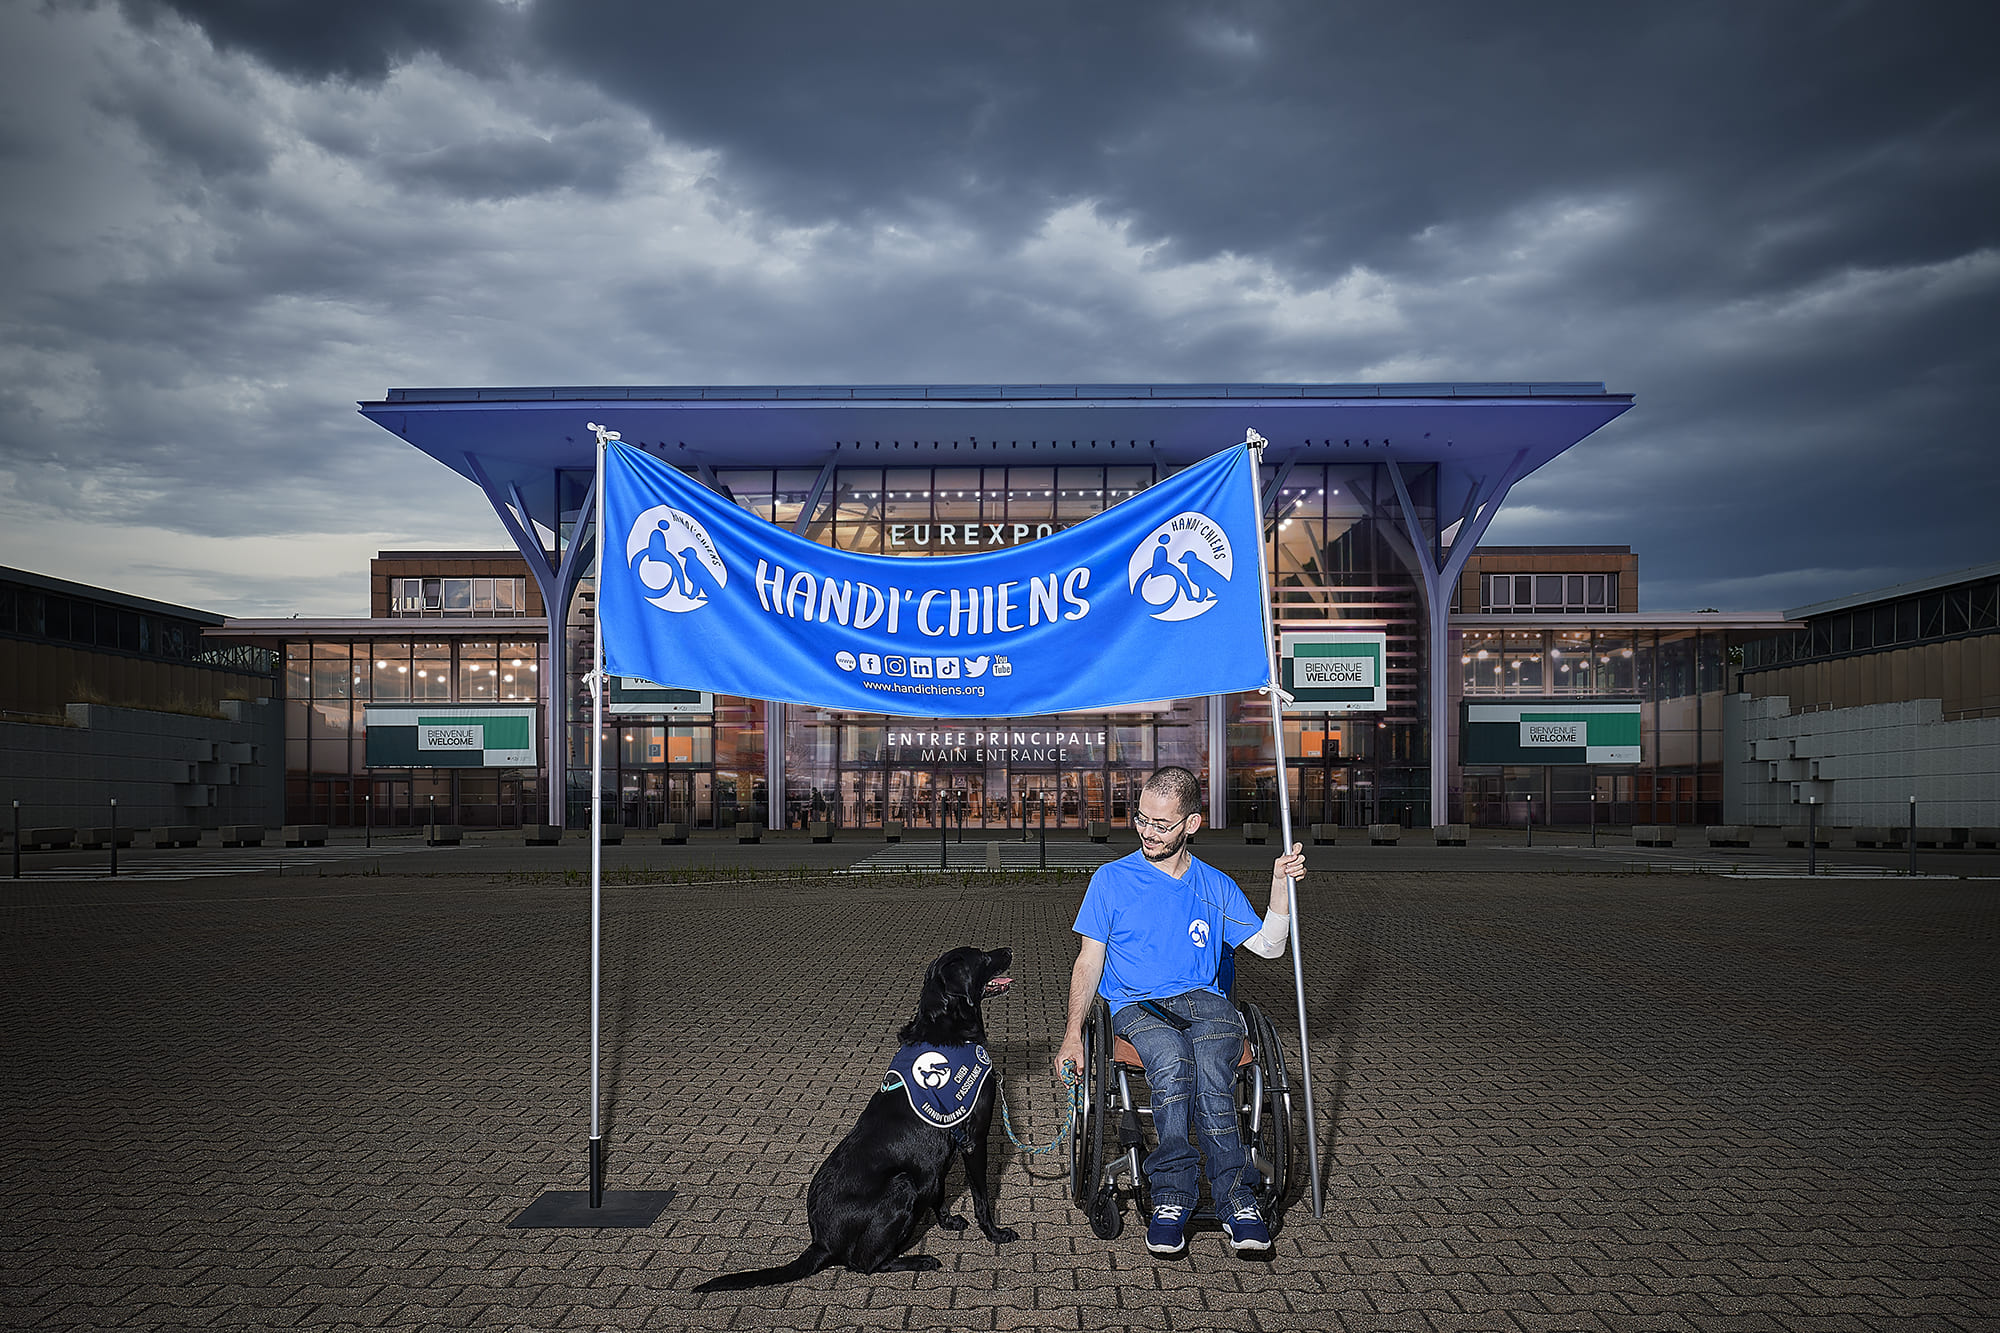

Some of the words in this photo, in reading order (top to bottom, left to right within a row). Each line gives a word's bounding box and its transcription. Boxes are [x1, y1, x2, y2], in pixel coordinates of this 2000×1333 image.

[1171, 517, 1227, 561] HANDI'CHIENS
[755, 558, 1091, 637] HANDI'CHIENS
[994, 654, 1008, 664] You
[994, 664, 1011, 676] Tube
[1305, 662, 1362, 672] BIENVENUE
[1306, 672, 1363, 682] WELCOME
[863, 680, 985, 697] www.handichiens.org
[427, 729, 474, 738] BIENVENUE
[1529, 726, 1577, 735] BIENVENUE
[428, 737, 474, 746] WELCOME
[887, 732, 967, 746] ENTREE
[975, 732, 1106, 746] PRINCIPALE
[1530, 734, 1577, 743] WELCOME
[921, 748, 967, 762] MAIN
[976, 748, 1067, 762] ENTRANCE
